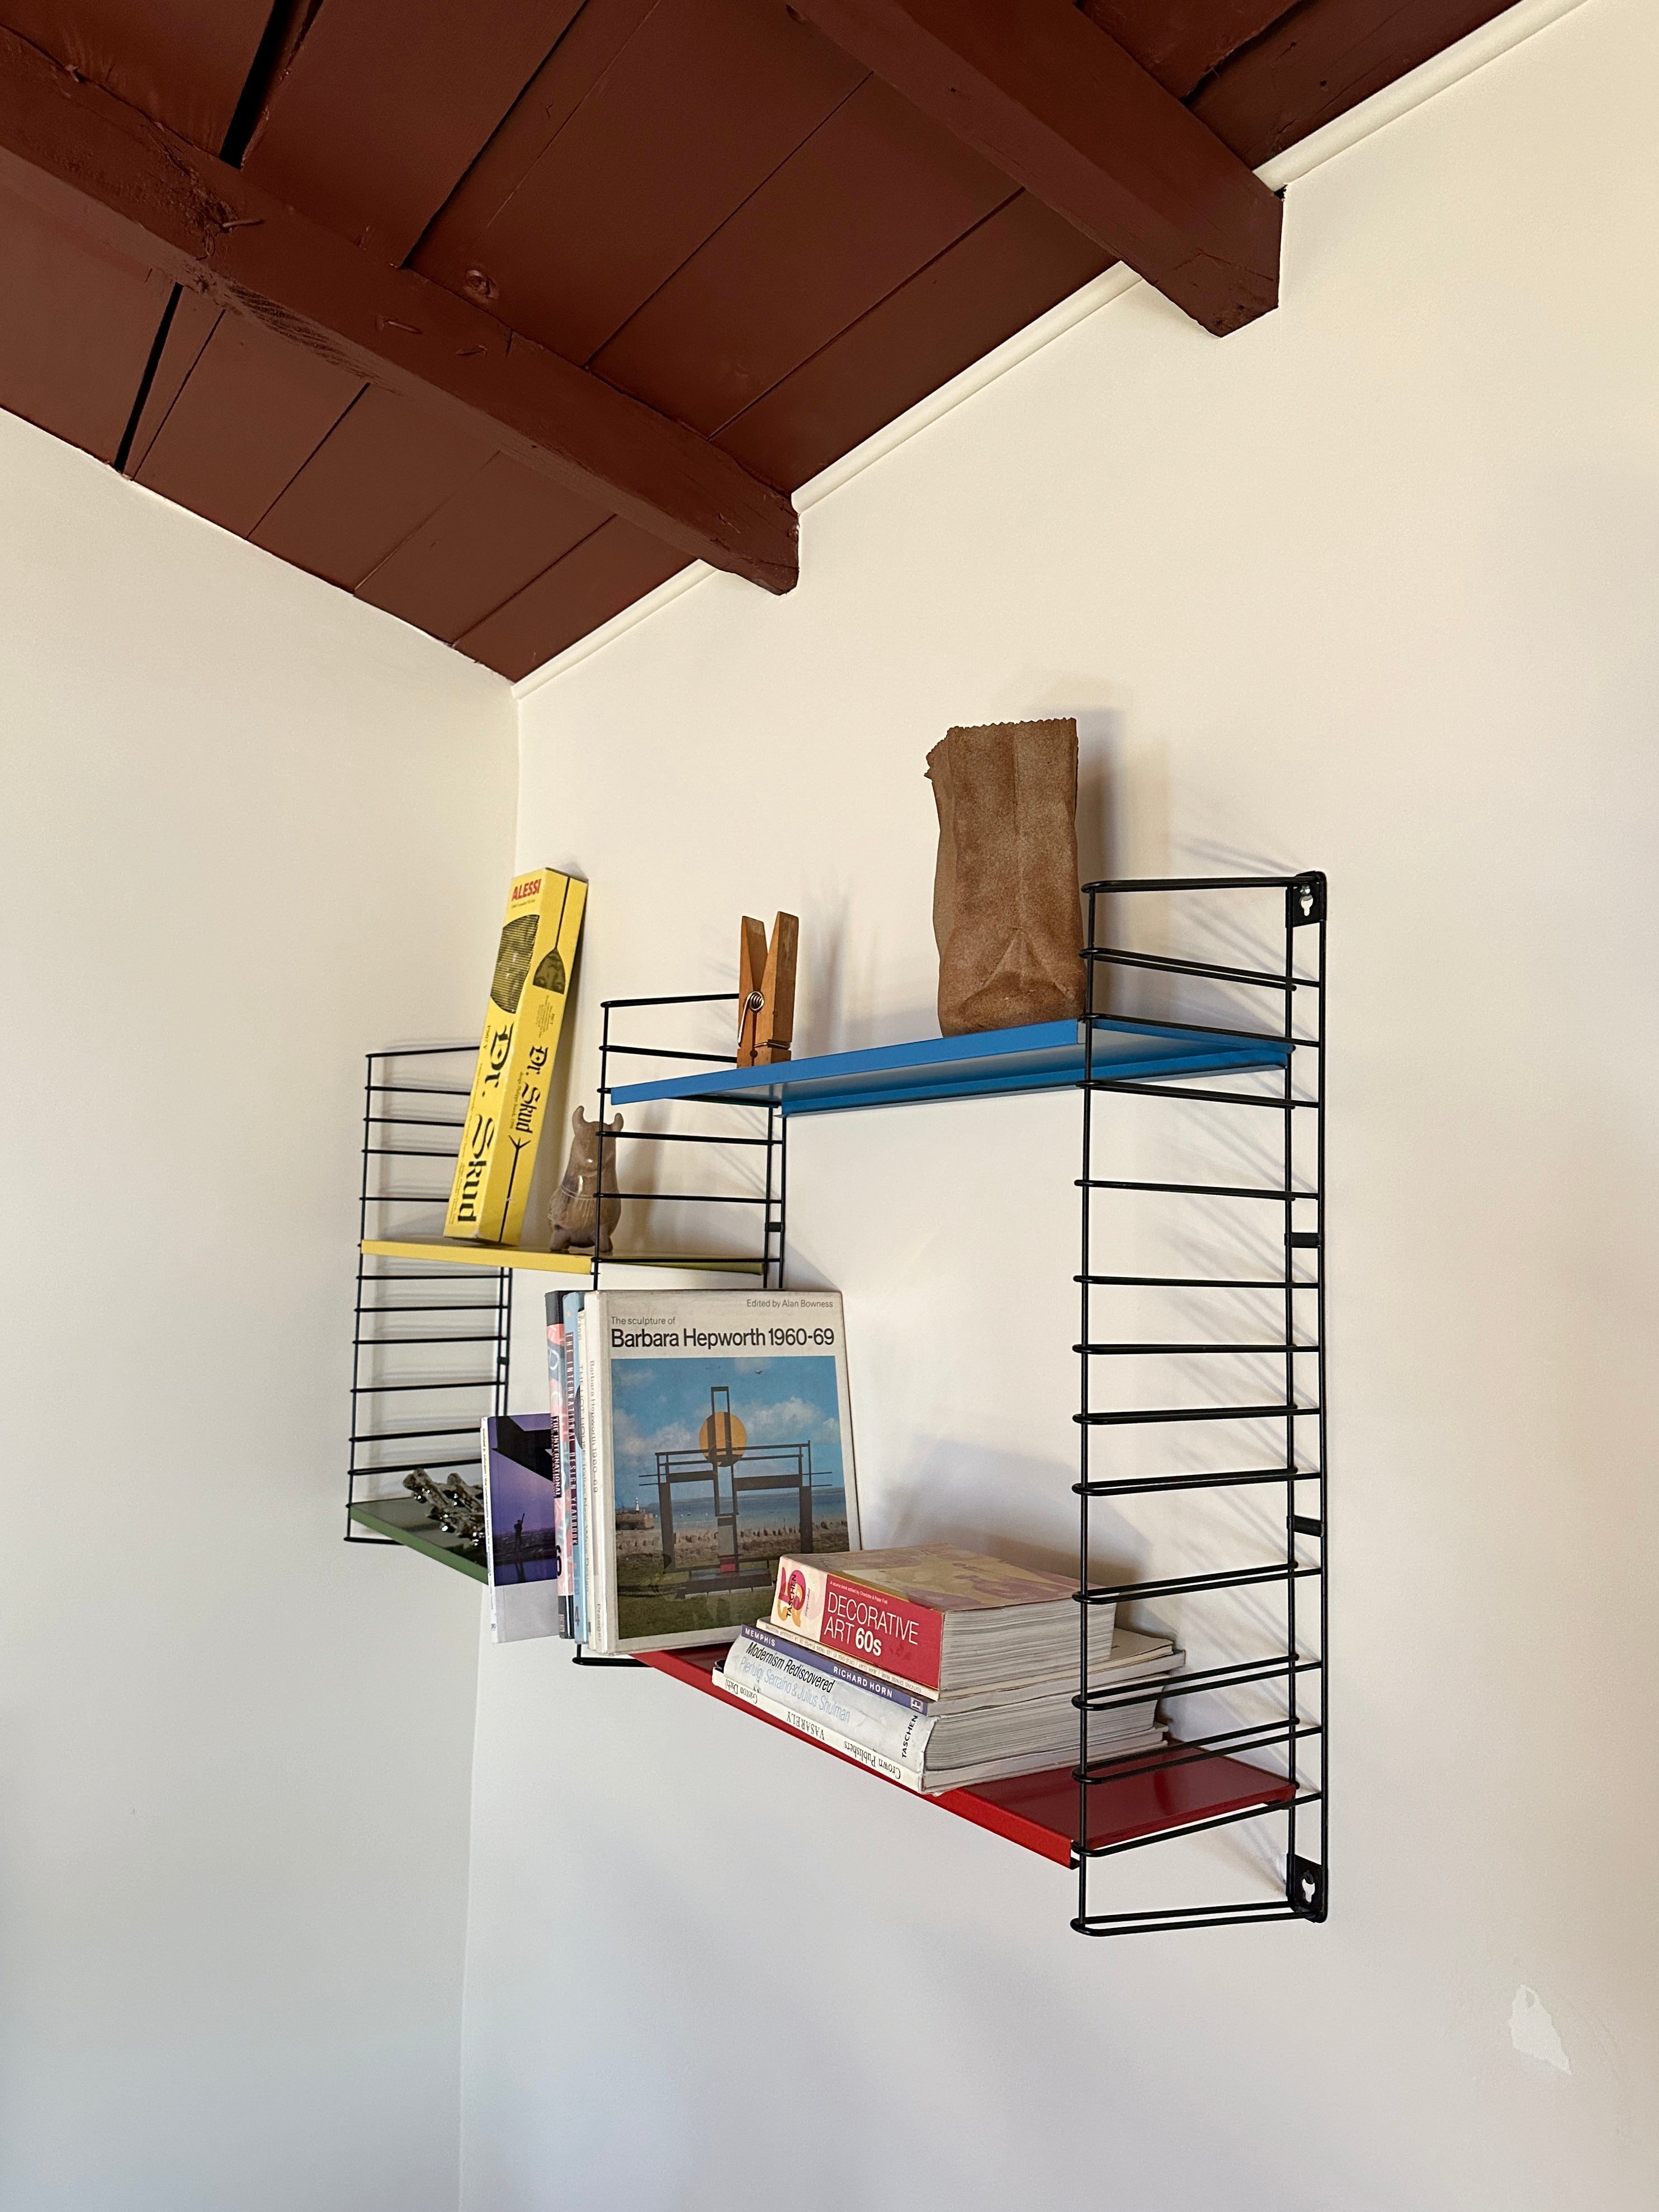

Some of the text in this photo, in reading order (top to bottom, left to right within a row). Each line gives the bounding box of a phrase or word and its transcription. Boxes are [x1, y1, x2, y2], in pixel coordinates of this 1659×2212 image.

[512, 878, 541, 901] ALESSI
[481, 1022, 515, 1098] Dr.
[525, 1047, 549, 1076] Dr.
[516, 1086, 541, 1135] Skud
[458, 1113, 495, 1223] Skud
[611, 1316, 676, 1326] The sculpture of
[746, 1299, 771, 1307] Edited
[772, 1299, 781, 1308] by
[611, 1328, 834, 1350] Barbara Hepworth 1960-69
[566, 1361, 576, 1442] INTERNATIONAL
[786, 1574, 797, 1617] TASCHEN
[828, 1591, 919, 1645] DECORATIVE
[824, 1616, 882, 1656] ART 60s
[745, 1627, 892, 1698] MEMPHIS RICHARD HORN
[746, 1642, 836, 1693] Modernism Rediscovered
[739, 1656, 850, 1723] Pierluigi Serraino & Julius Shulman
[725, 1679, 901, 1780] Crown Publishers VASARELY Gaston Diehl
[902, 1715, 918, 1758] TASCHEN
